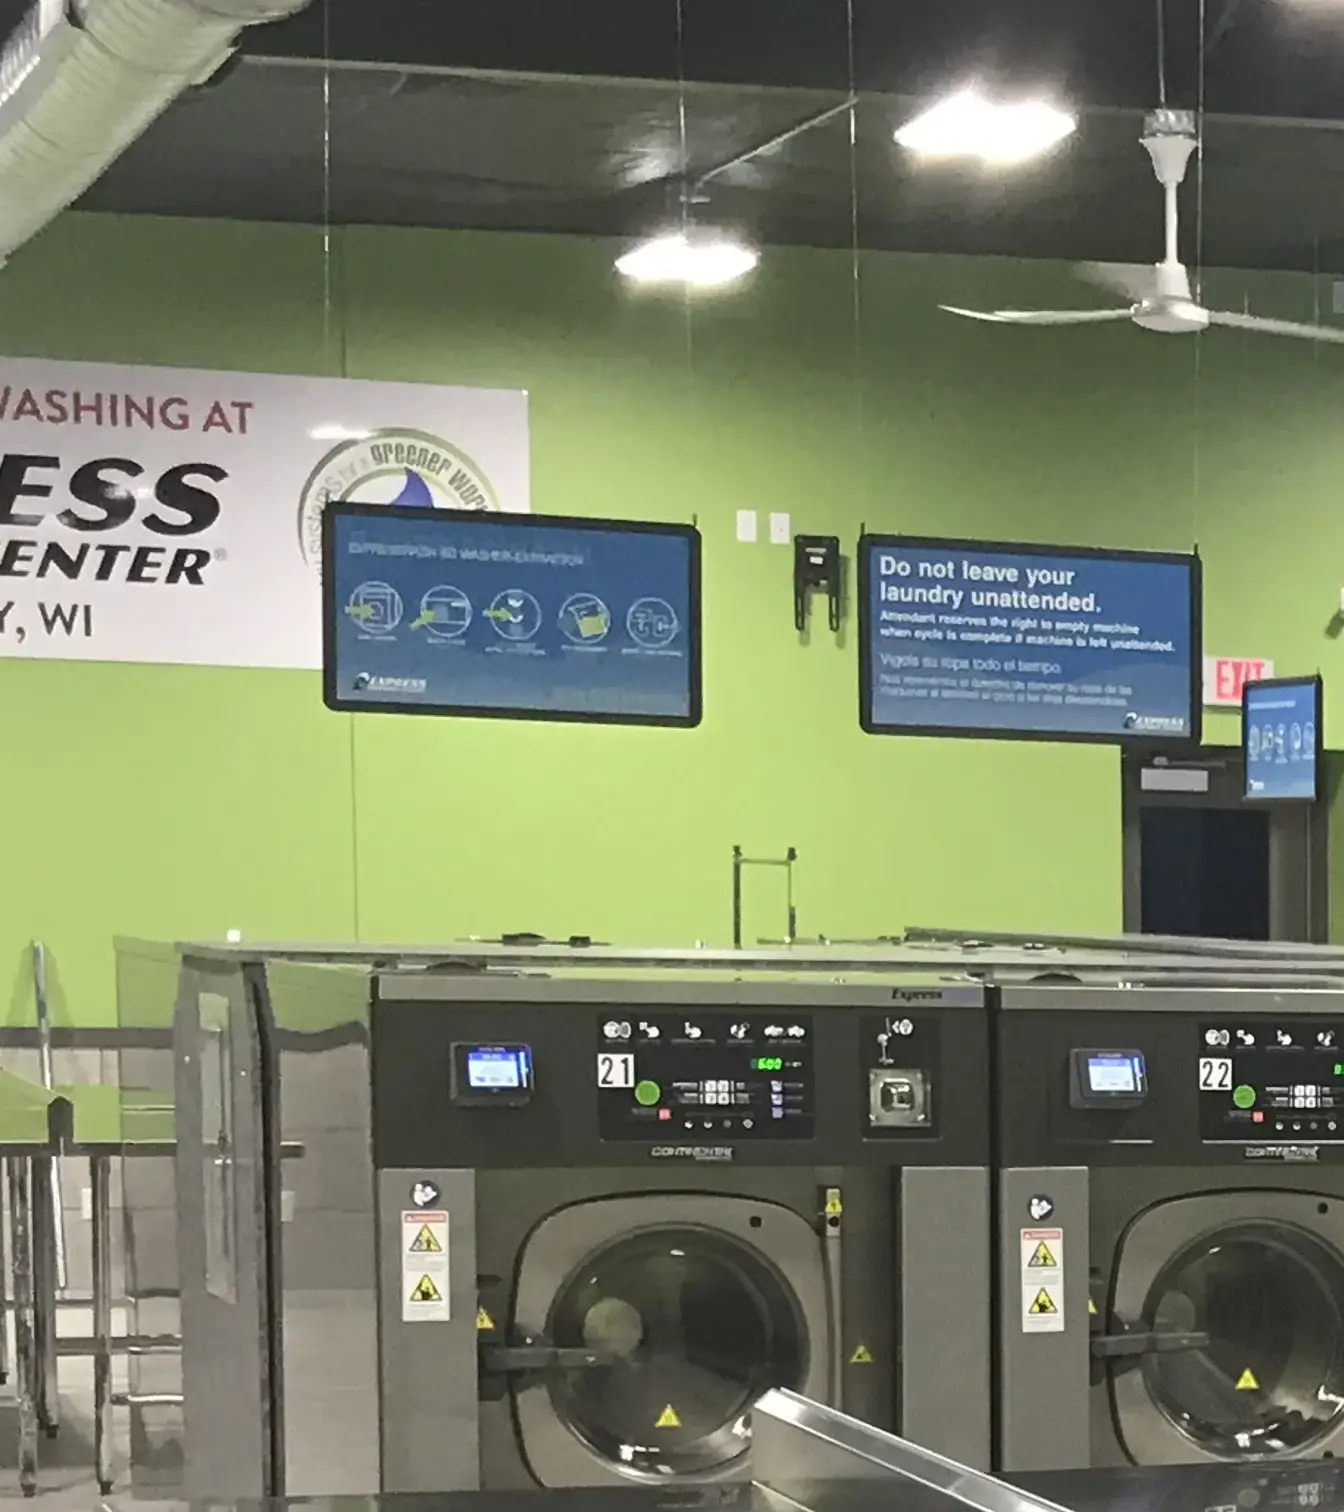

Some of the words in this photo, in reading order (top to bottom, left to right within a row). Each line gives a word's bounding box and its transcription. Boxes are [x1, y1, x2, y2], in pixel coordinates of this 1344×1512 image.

[202, 401, 254, 434] AT
[370, 443, 452, 476] greener
[880, 556, 910, 577] Do
[919, 560, 954, 579] not
[963, 561, 1018, 582] leave
[1026, 567, 1075, 588] your
[880, 582, 963, 609] laundry
[971, 591, 1101, 613] unattended.
[38, 601, 92, 636] WI
[1011, 616, 1037, 631] right
[601, 1056, 629, 1085] 21
[1202, 1060, 1230, 1088] 22
